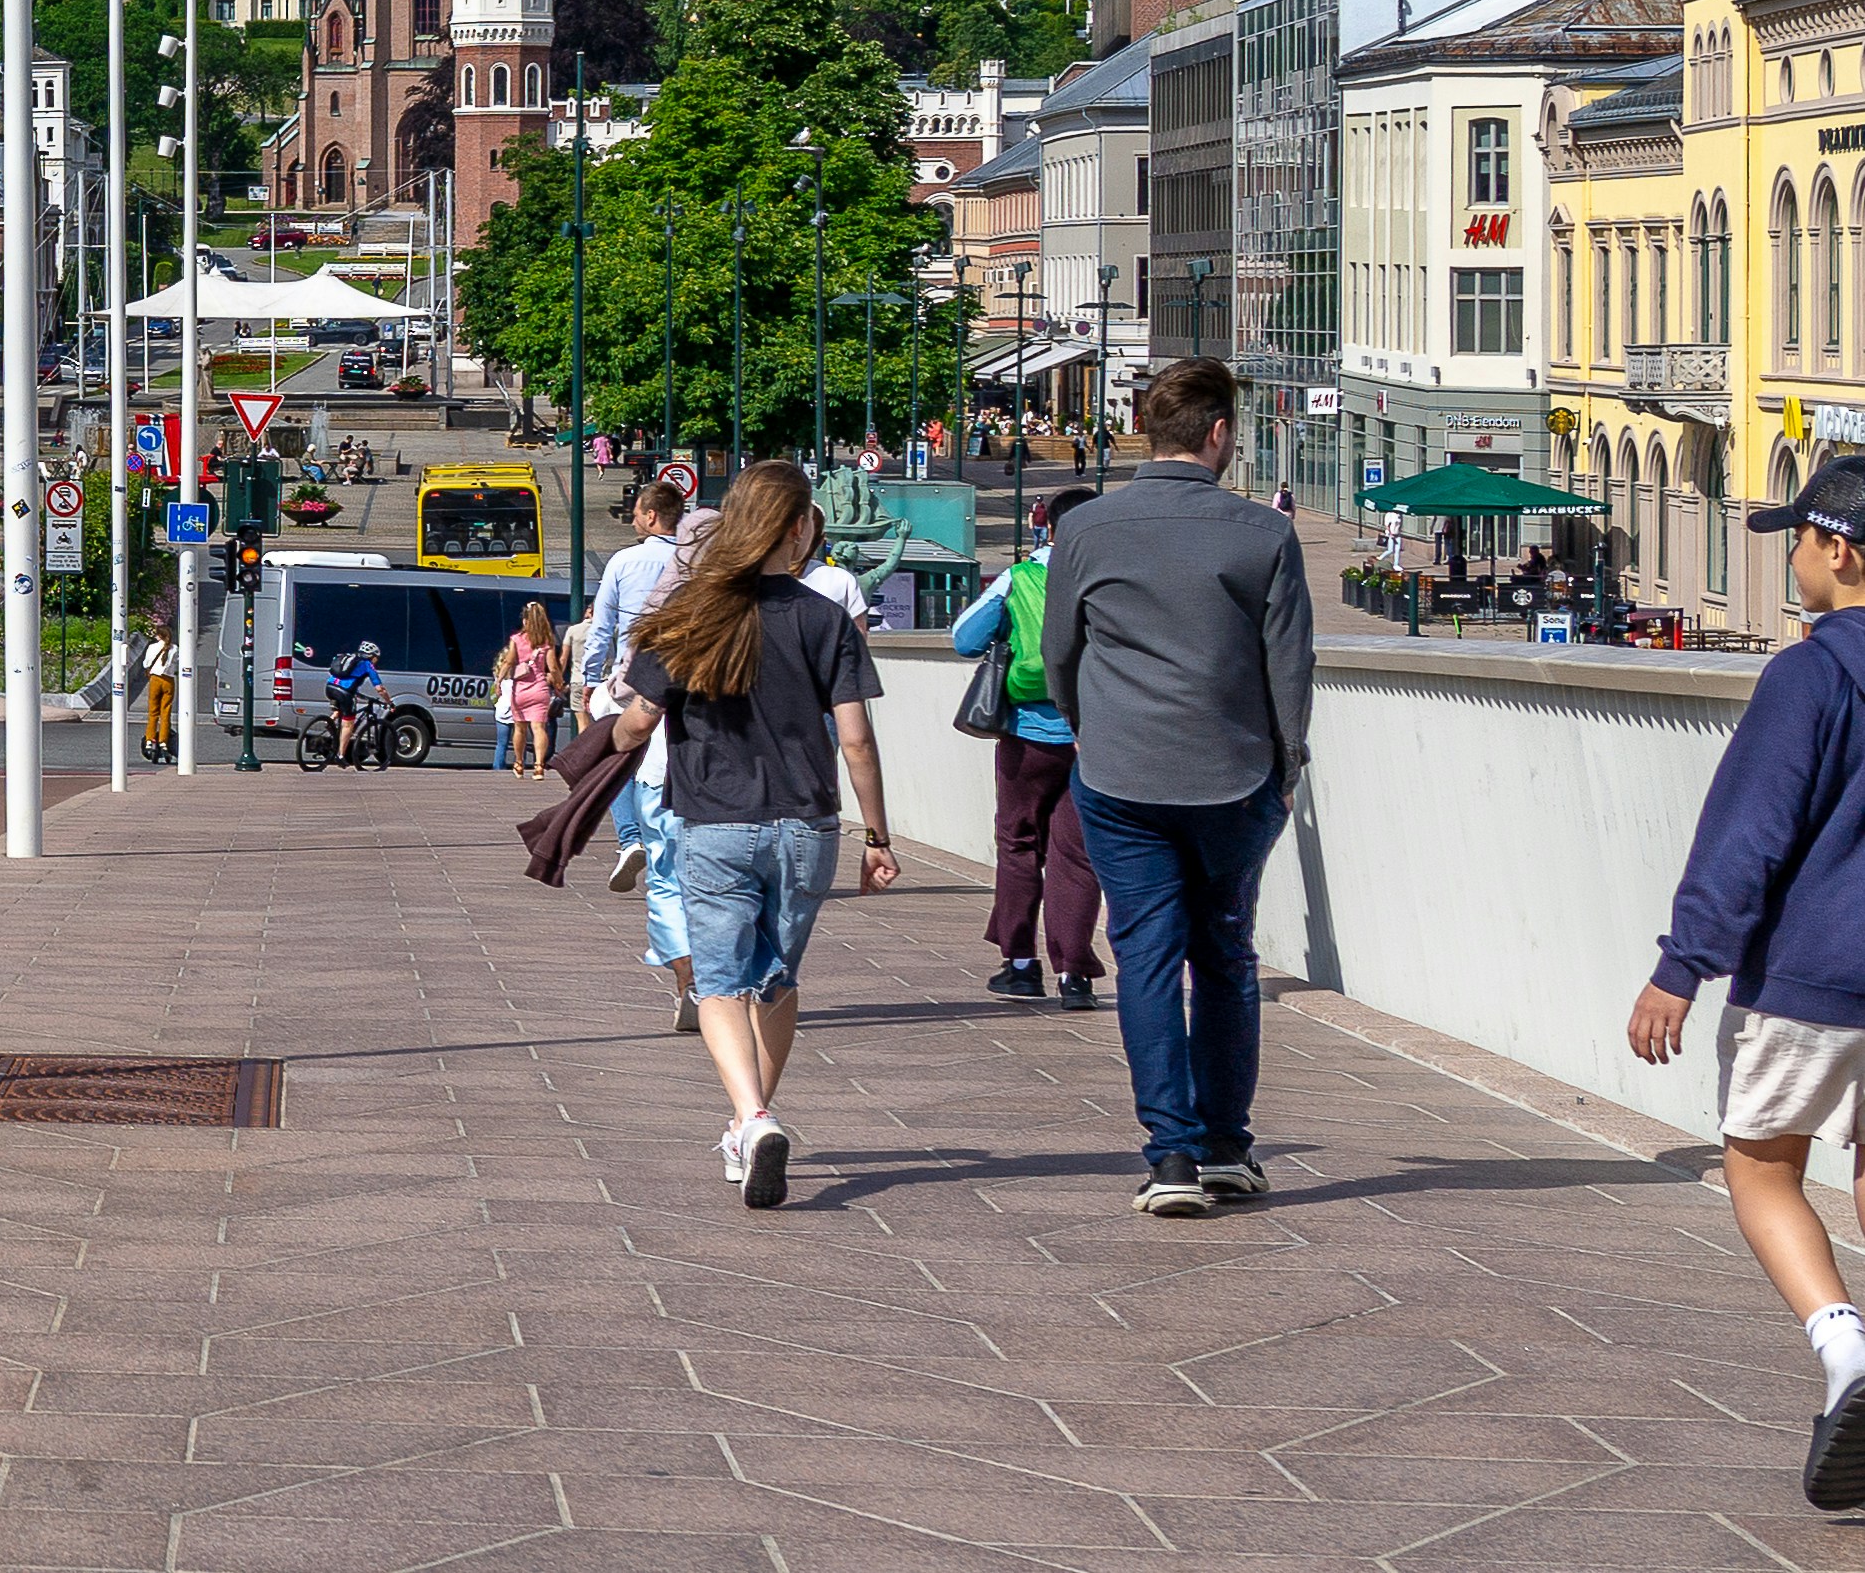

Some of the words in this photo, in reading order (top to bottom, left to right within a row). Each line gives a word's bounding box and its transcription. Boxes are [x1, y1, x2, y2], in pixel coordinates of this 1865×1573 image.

[1464, 214, 1510, 248] H&M
[1522, 506, 1601, 515] STARBUCKS
[426, 676, 489, 699] 05060
